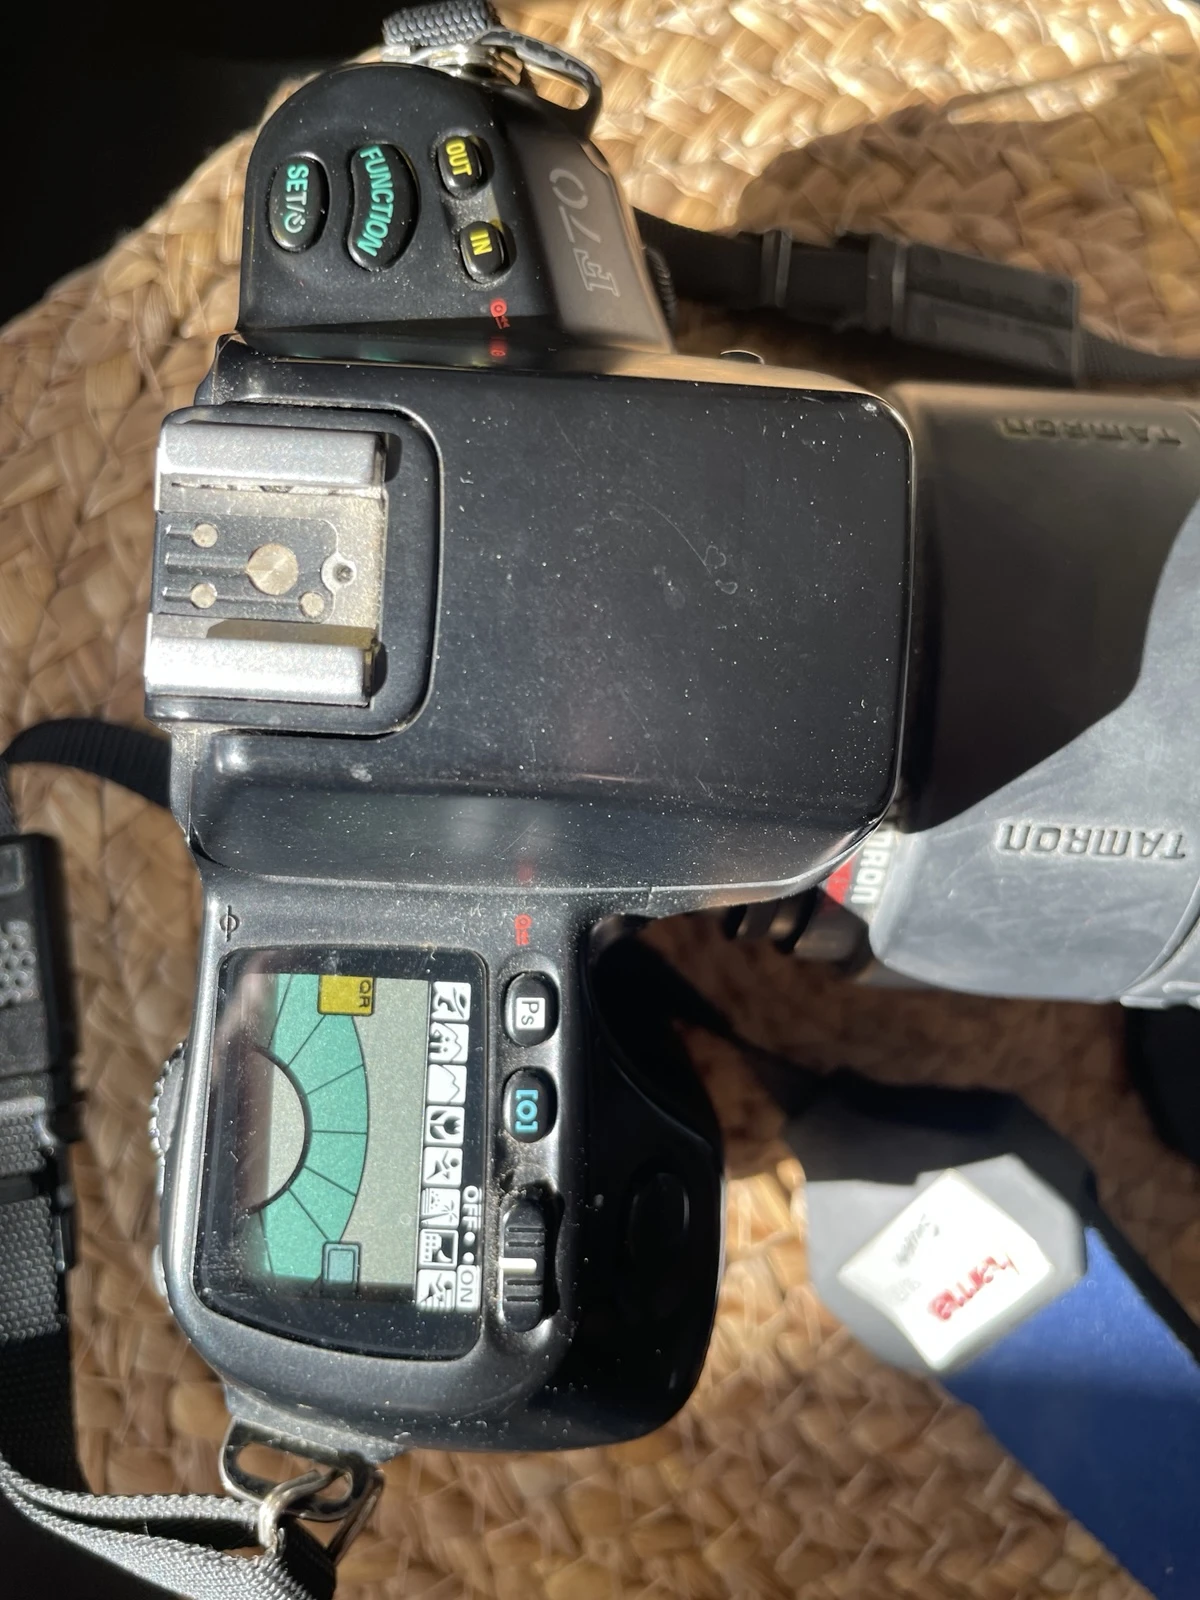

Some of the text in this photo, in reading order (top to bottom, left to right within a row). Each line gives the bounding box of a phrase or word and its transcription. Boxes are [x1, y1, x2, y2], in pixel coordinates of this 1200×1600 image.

[445, 139, 471, 176] OUT
[358, 145, 395, 257] FUNCTION
[468, 229, 493, 256] IN
[551, 168, 620, 297] F70
[1001, 418, 1182, 444] TAMRON
[1000, 824, 1186, 859] TAMRON
[358, 979, 372, 1009] QR
[521, 1001, 540, 1026] Ps
[462, 1185, 480, 1231] OFF
[459, 1269, 474, 1303] ON
